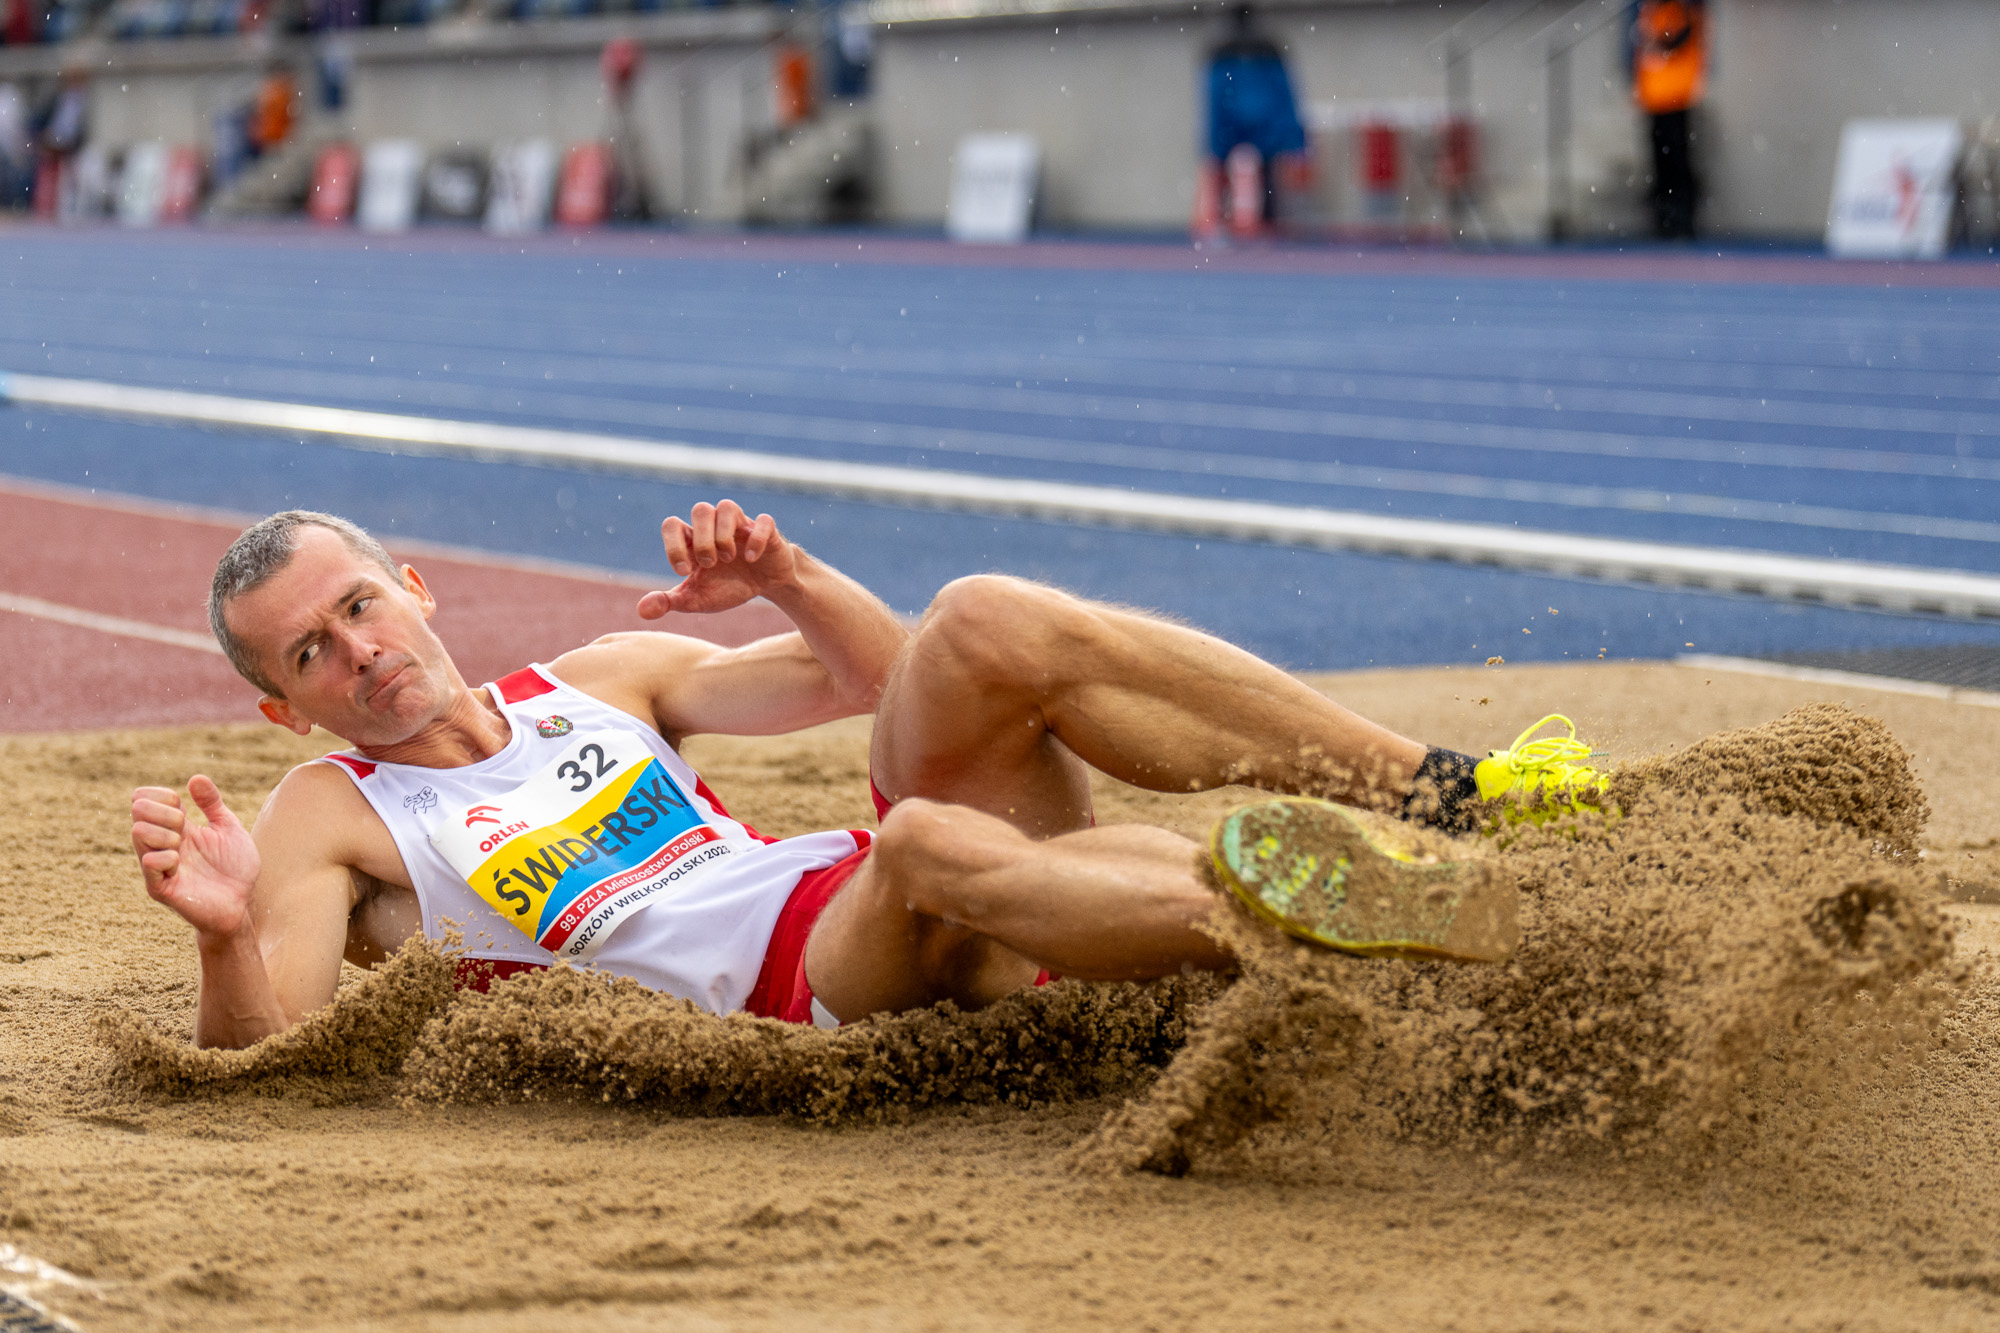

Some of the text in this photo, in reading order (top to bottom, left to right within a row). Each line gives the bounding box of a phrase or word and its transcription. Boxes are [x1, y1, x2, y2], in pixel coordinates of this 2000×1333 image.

[557, 743, 619, 793] 32
[479, 820, 530, 853] ORLEN
[492, 774, 691, 917] ŚWIDERSKI
[559, 831, 707, 933] 99. PZLA Mistrzostwa Polski
[568, 905, 616, 956] GORZÓW
[613, 853, 707, 909] WIELKOPOLSKI
